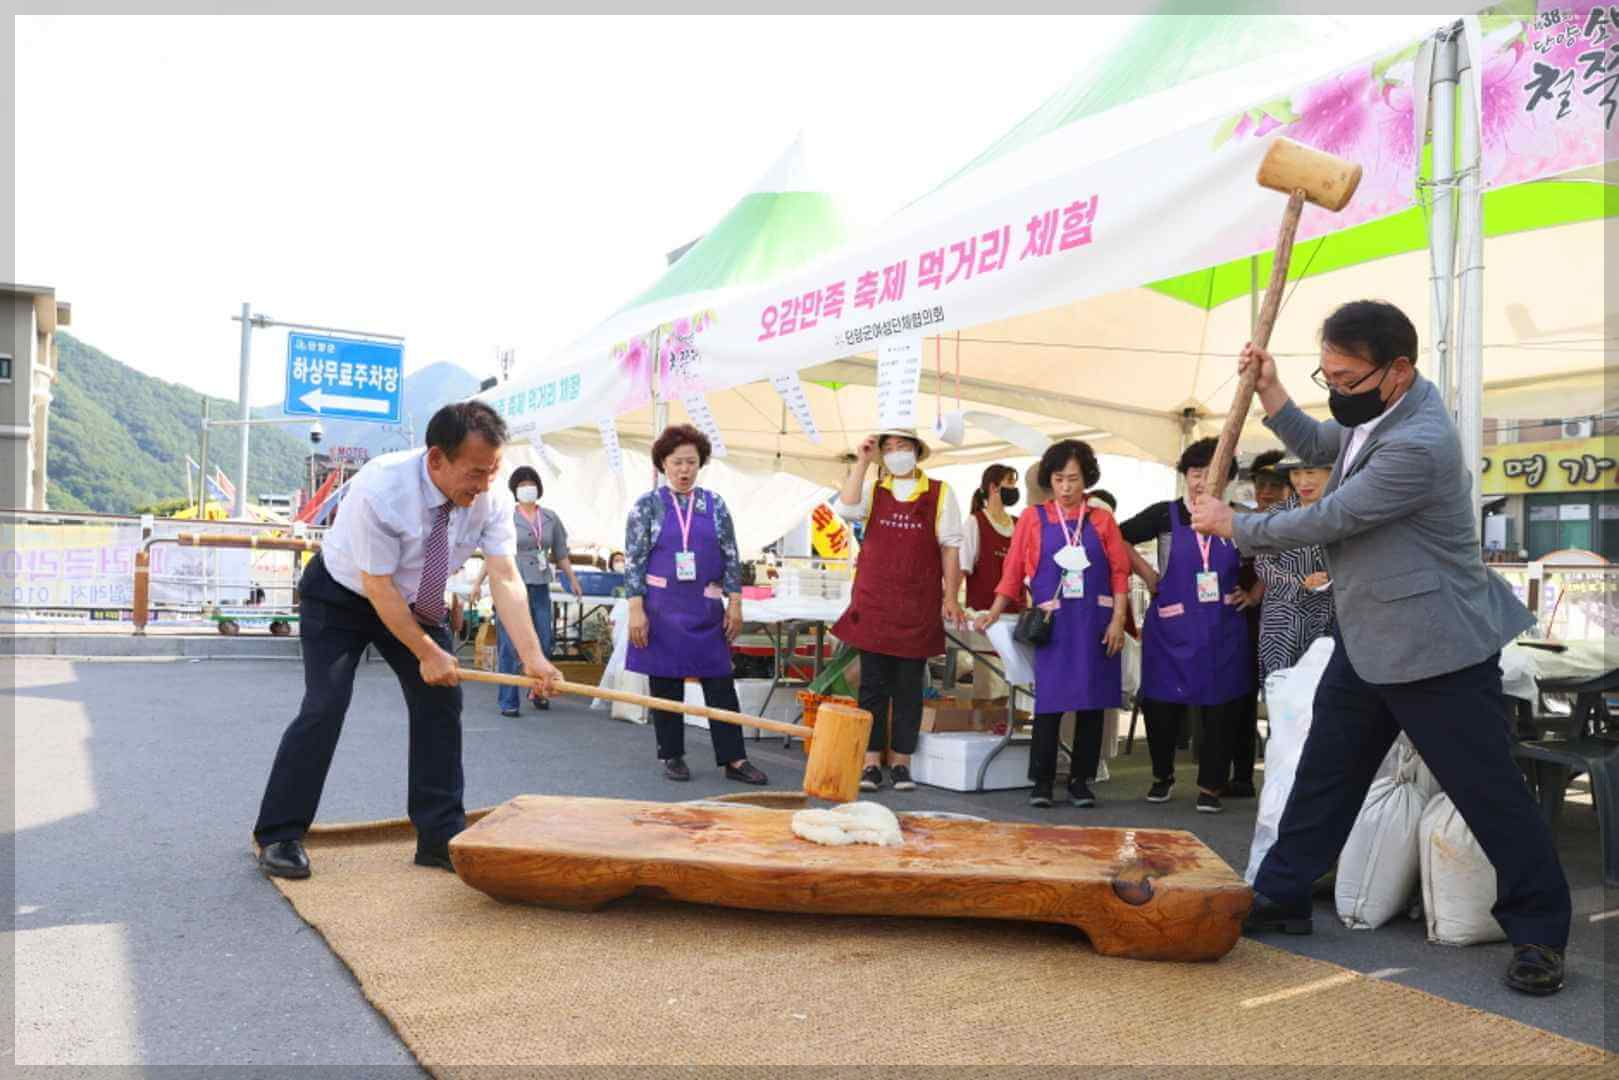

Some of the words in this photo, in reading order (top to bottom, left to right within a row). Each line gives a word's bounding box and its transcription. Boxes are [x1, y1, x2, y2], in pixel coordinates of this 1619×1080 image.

[758, 280, 846, 343] 오감만족
[853, 260, 907, 311] 축제
[916, 224, 1012, 290] 먹거리
[1019, 194, 1100, 261] 체험
[293, 356, 399, 393] 하상무료주차장
